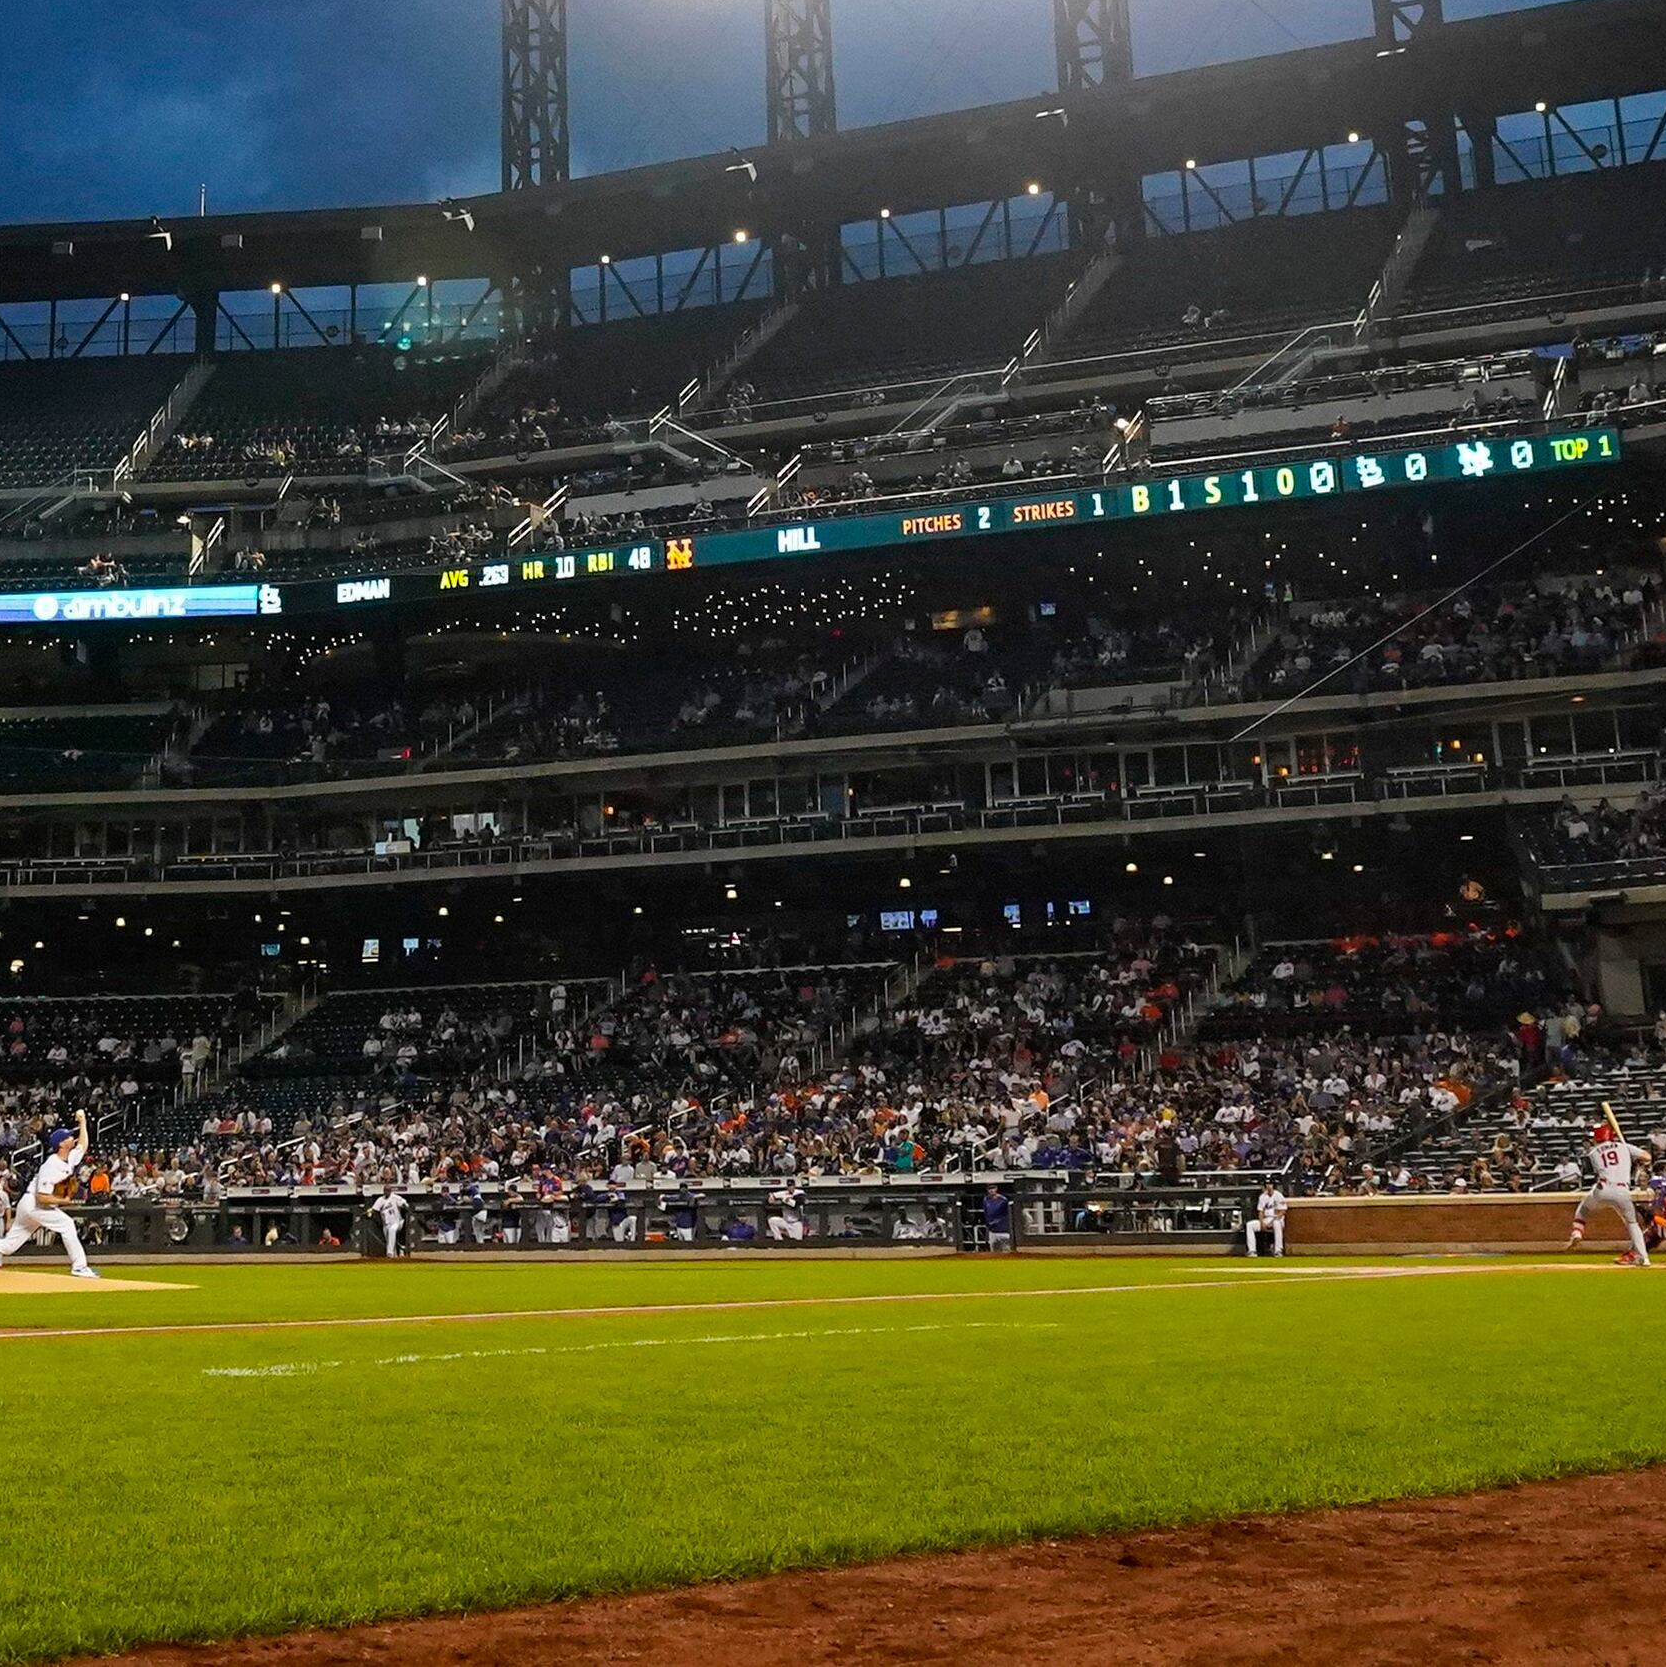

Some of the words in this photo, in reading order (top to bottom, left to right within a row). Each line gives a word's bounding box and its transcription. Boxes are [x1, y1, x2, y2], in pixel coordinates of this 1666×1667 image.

[1168, 479, 1186, 511] 1
[1205, 476, 1222, 505] S
[1241, 471, 1259, 502] 1
[1550, 437, 1589, 462] TOP
[1599, 434, 1613, 457] 1
[902, 513, 962, 535] PITCHES
[978, 506, 991, 529] 2
[1013, 500, 1074, 524] STRIKES
[1093, 493, 1104, 516] 1
[778, 527, 820, 553] HILL
[337, 579, 391, 604] EDMAN
[440, 569, 469, 590] AVG
[522, 560, 544, 581] HR
[555, 556, 575, 580] 10
[587, 552, 614, 573] RBI
[628, 546, 651, 570] 48
[63, 591, 187, 618] ambulnz
[1601, 1150, 1619, 1168] 19
